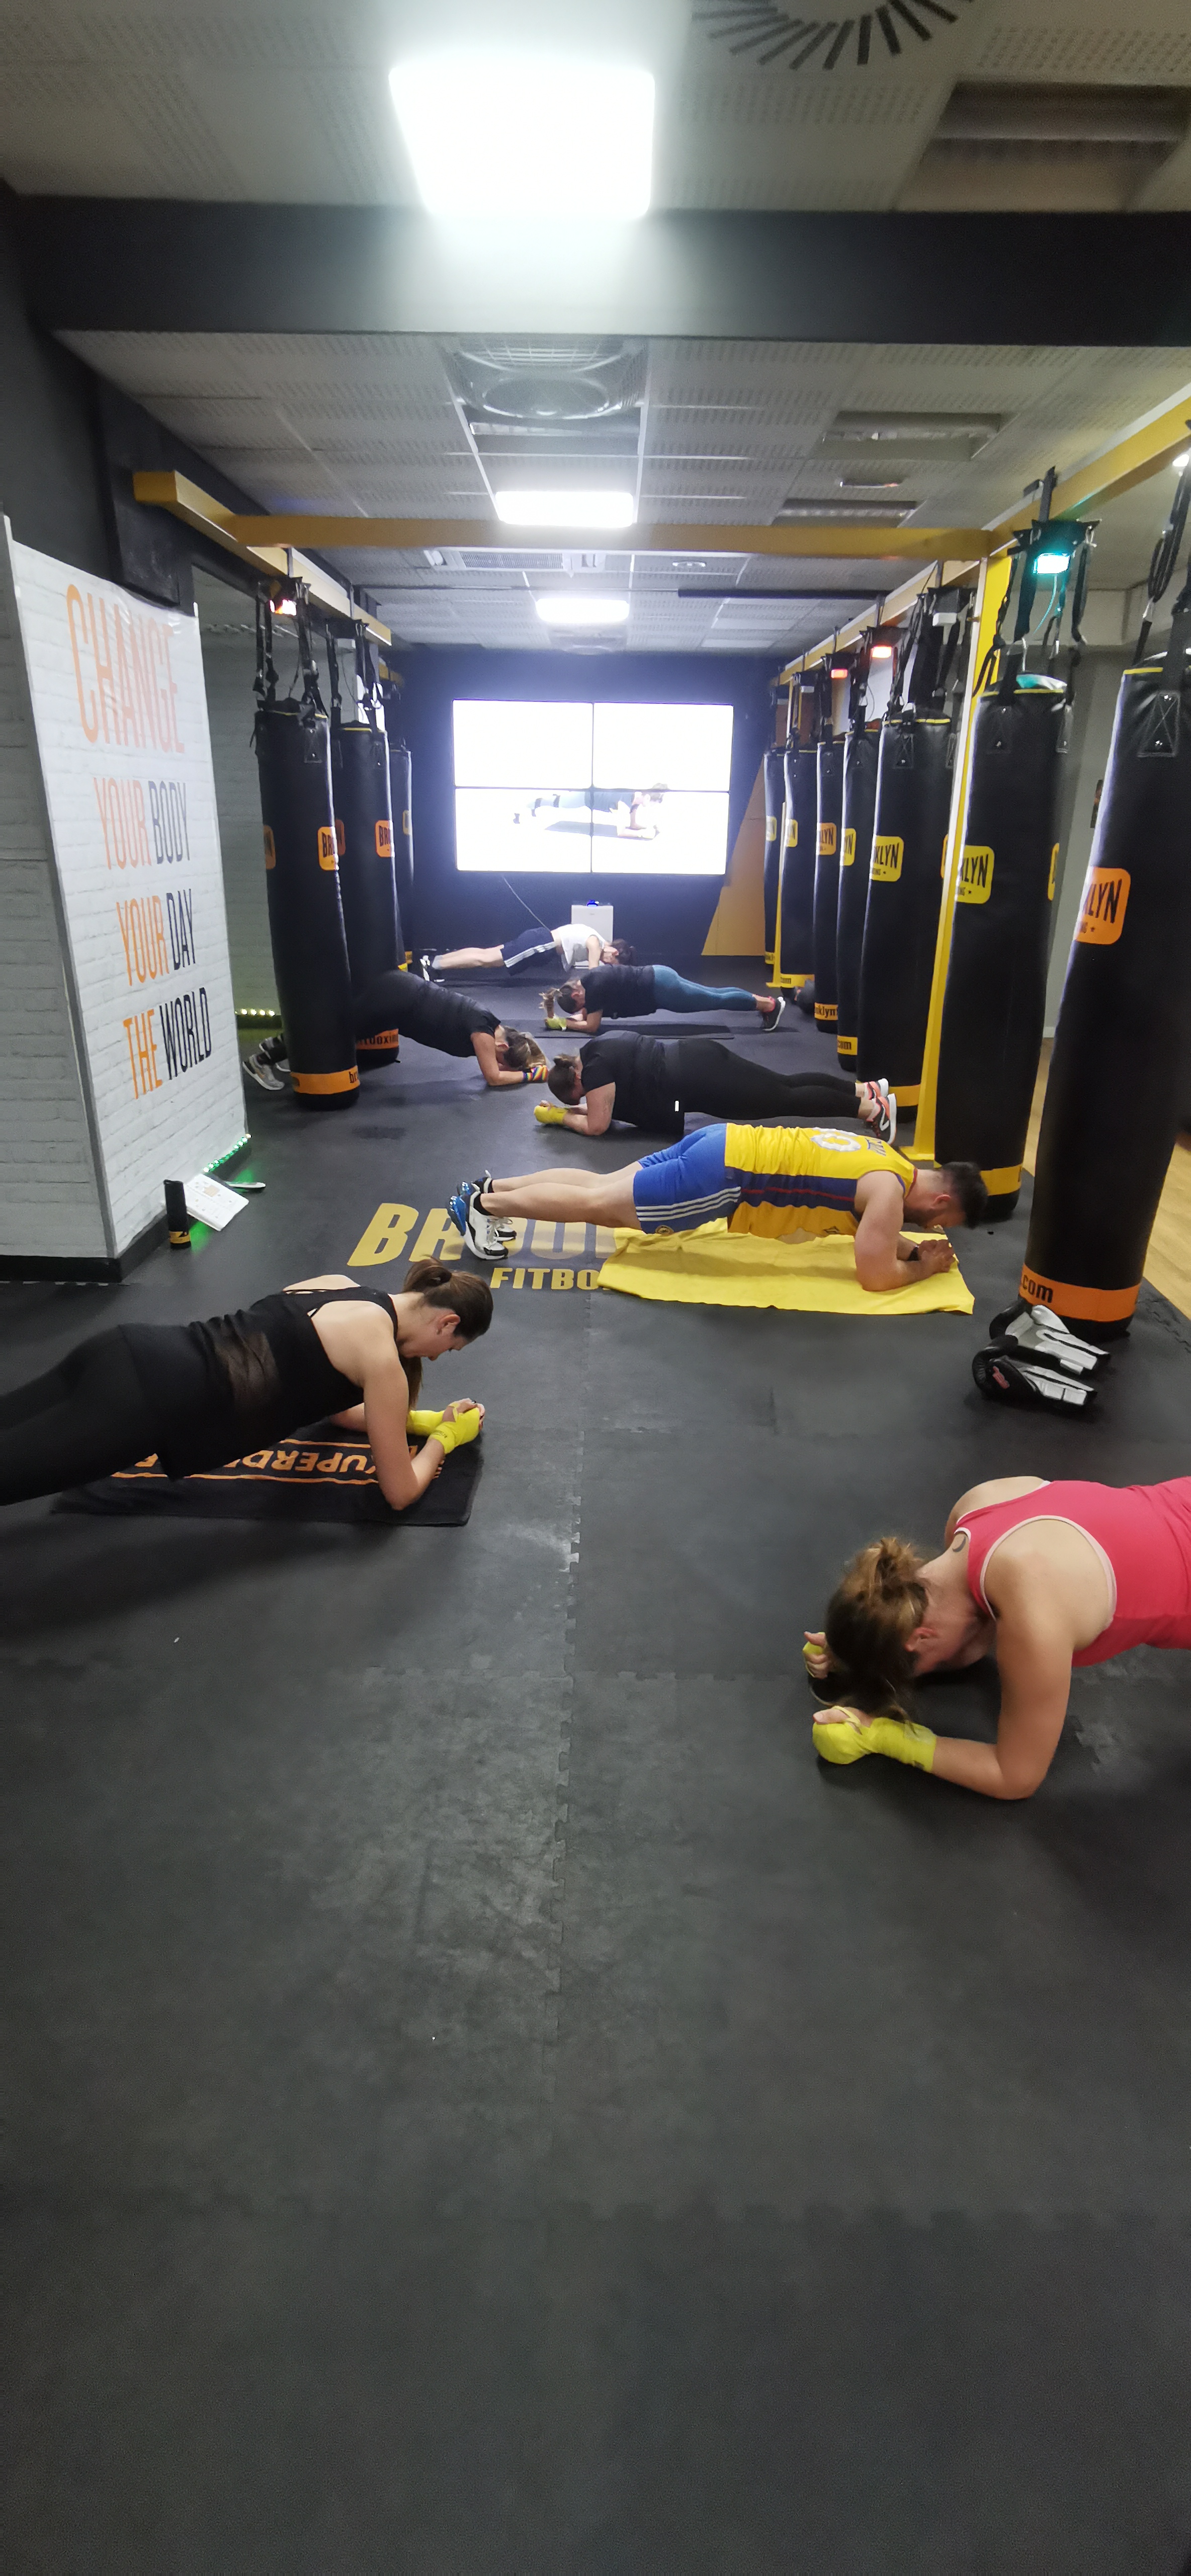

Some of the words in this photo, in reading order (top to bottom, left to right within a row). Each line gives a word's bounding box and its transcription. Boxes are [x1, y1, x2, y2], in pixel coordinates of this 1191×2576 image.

[66, 584, 185, 753] CHANGE
[93, 777, 151, 870] YOUR
[148, 780, 190, 864] BODY
[116, 895, 170, 987] YOUR
[166, 889, 196, 971] DAY
[122, 1008, 163, 1100] THE
[159, 987, 212, 1081] WORLD
[490, 1267, 611, 1291] FITBO
